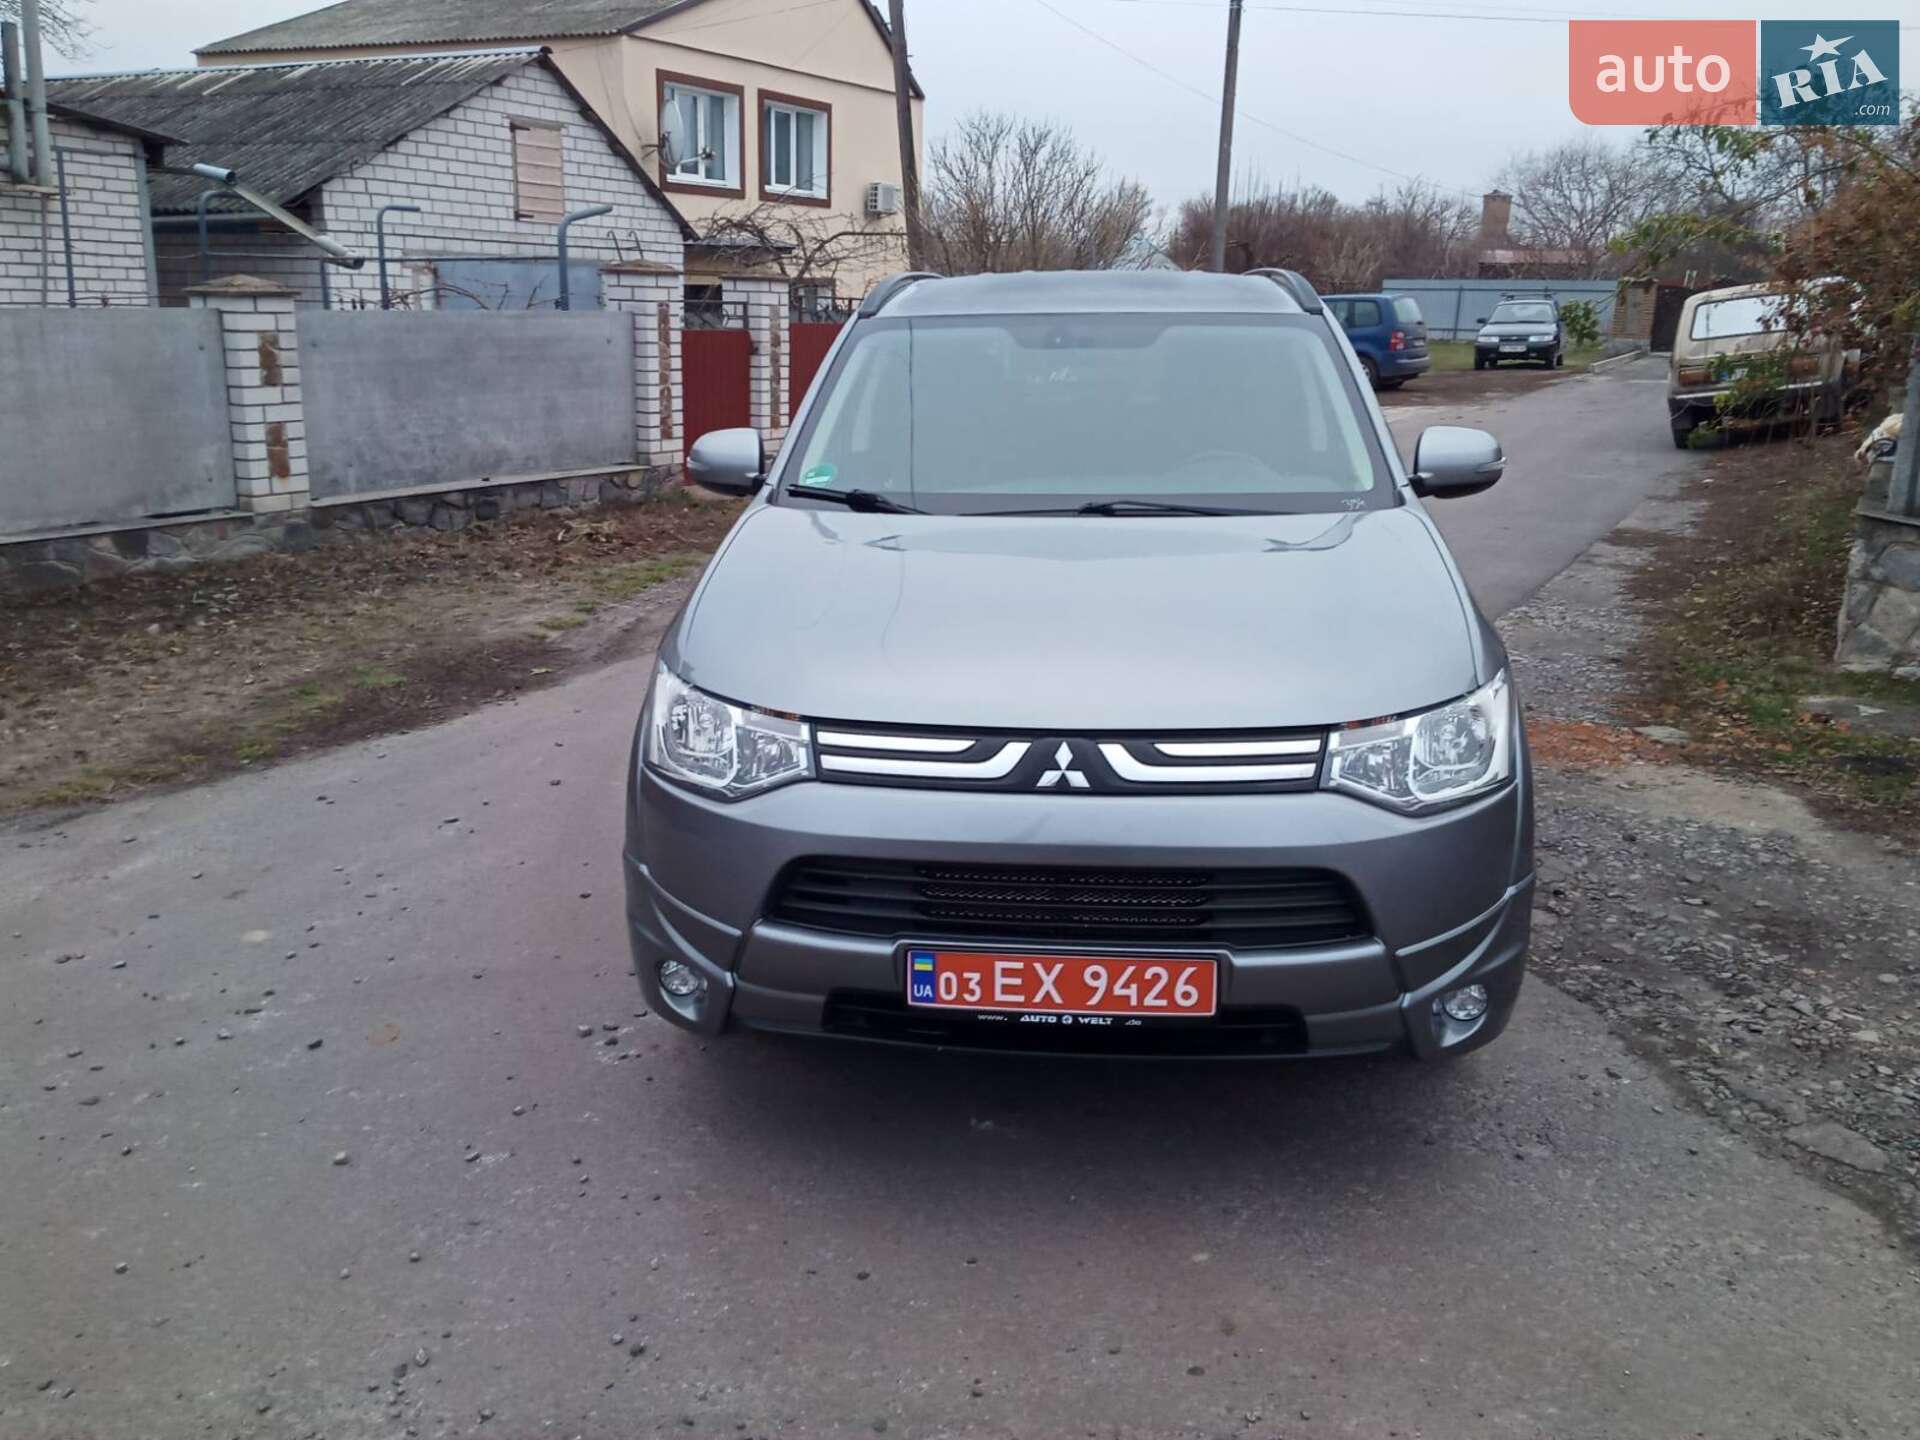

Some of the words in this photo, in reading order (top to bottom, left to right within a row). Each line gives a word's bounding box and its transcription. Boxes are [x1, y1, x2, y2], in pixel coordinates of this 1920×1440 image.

[913, 984, 934, 998] UA
[939, 970, 982, 1003] 03
[994, 960, 1065, 1005] EX
[1082, 964, 1199, 1008] 9426
[1020, 1014, 1057, 1023] AUTO
[1078, 1016, 1113, 1025] WELT
